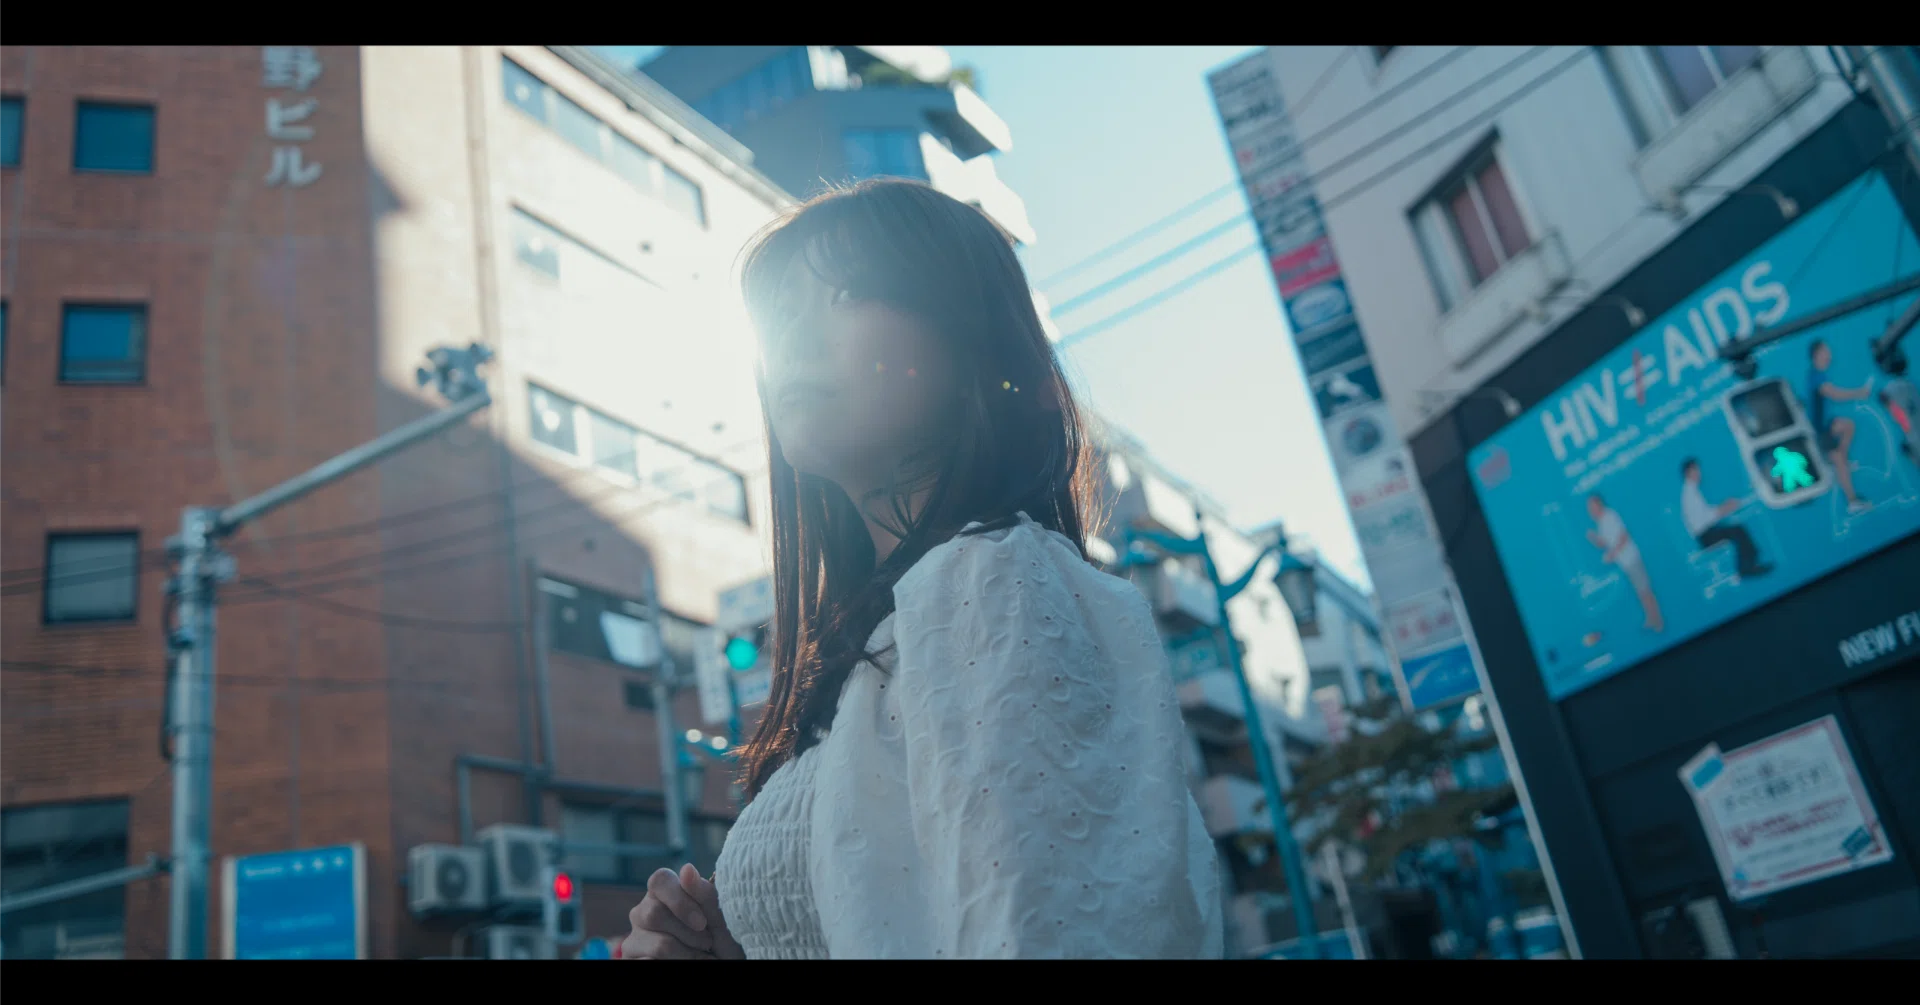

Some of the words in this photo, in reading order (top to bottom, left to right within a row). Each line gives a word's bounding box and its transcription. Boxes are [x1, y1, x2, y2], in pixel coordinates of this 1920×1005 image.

[1540, 367, 1619, 461] HIV
[1663, 260, 1790, 387] AIDS
[1838, 620, 1897, 668] NEW
